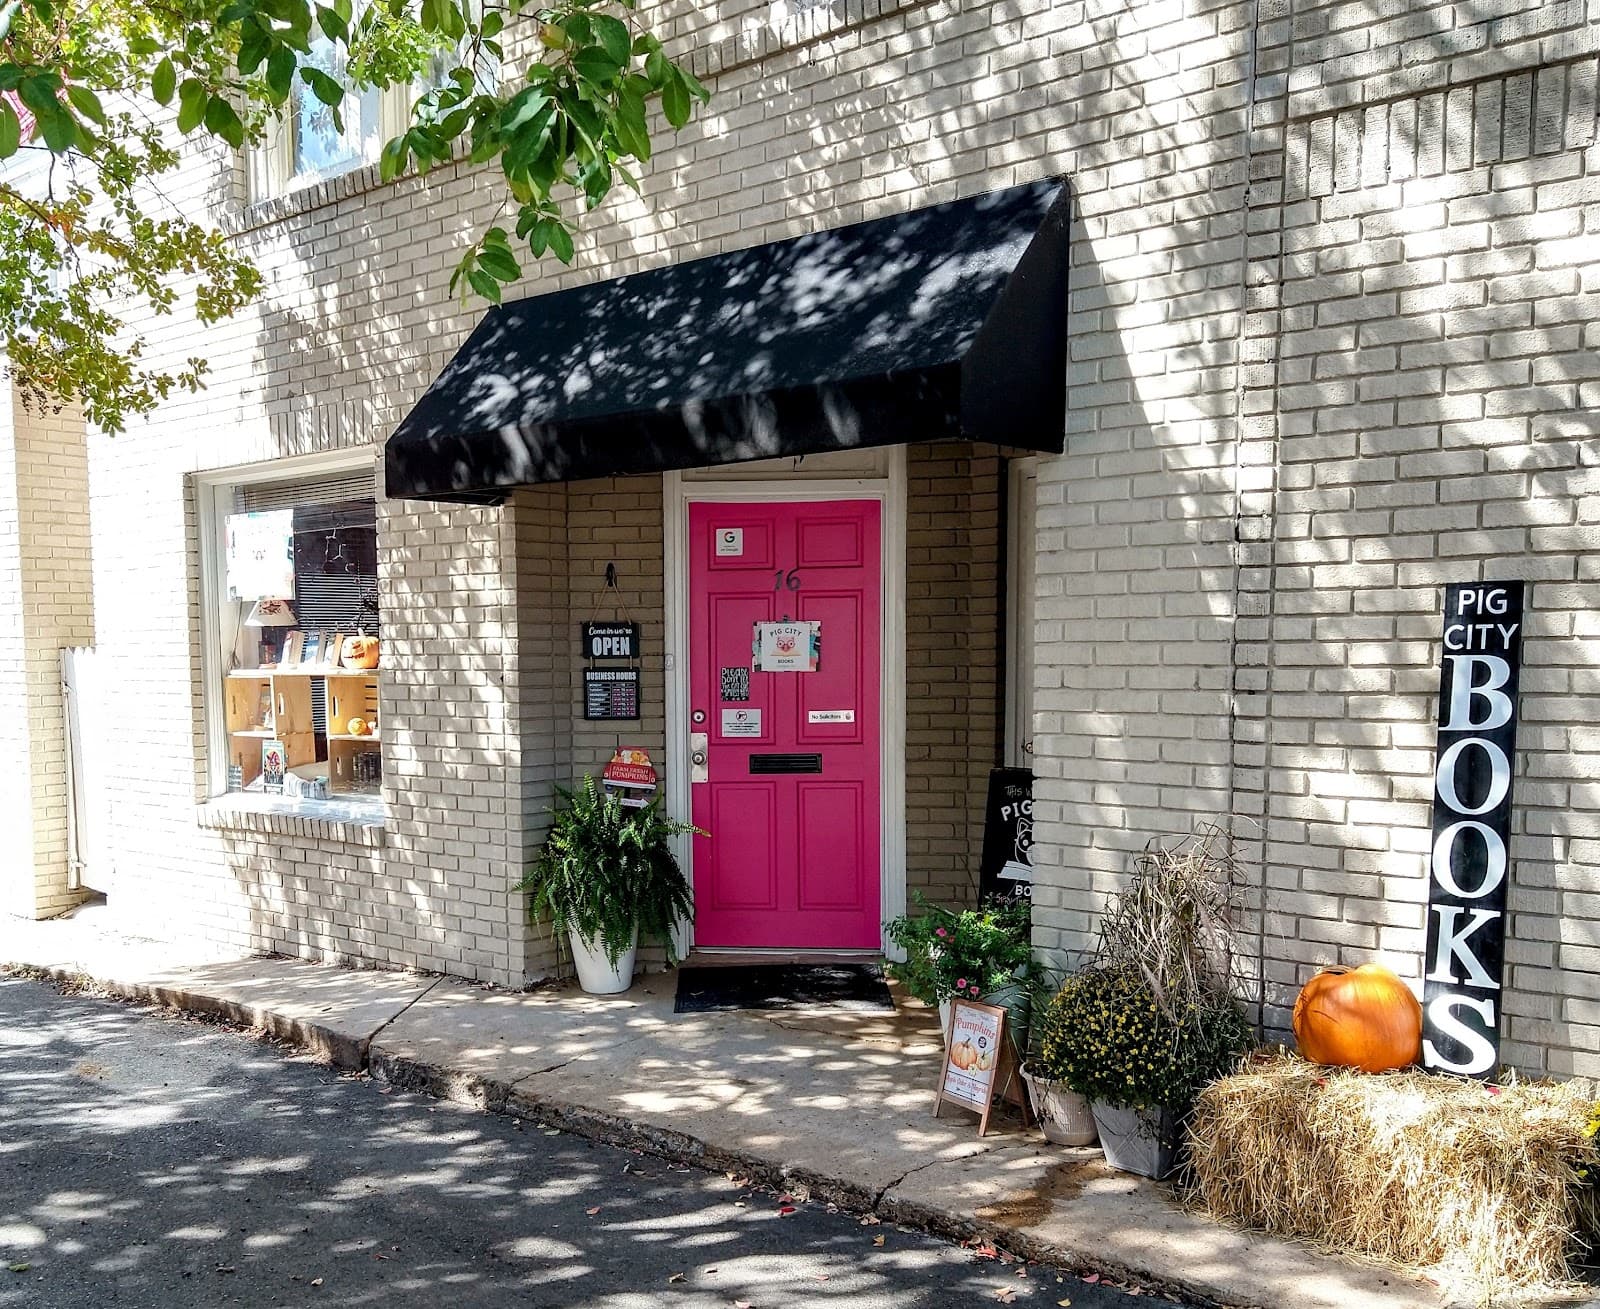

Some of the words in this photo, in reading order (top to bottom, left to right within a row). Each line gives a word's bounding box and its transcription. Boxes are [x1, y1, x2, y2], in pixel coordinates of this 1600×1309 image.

[774, 568, 801, 592] 16
[1457, 589, 1508, 616] PIG
[588, 626, 606, 636] Come
[770, 628, 782, 637] PIG
[784, 628, 802, 637] CITY
[1444, 623, 1519, 651] CITY
[592, 636, 630, 656] OPEN
[586, 671, 616, 680] BUSINESS
[616, 672, 636, 680] HOURS
[612, 771, 648, 780] PUMPKINS
[1001, 800, 1032, 821] PIG
[1423, 654, 1513, 1076] BOOKS
[955, 1017, 996, 1040] Pumpkins
